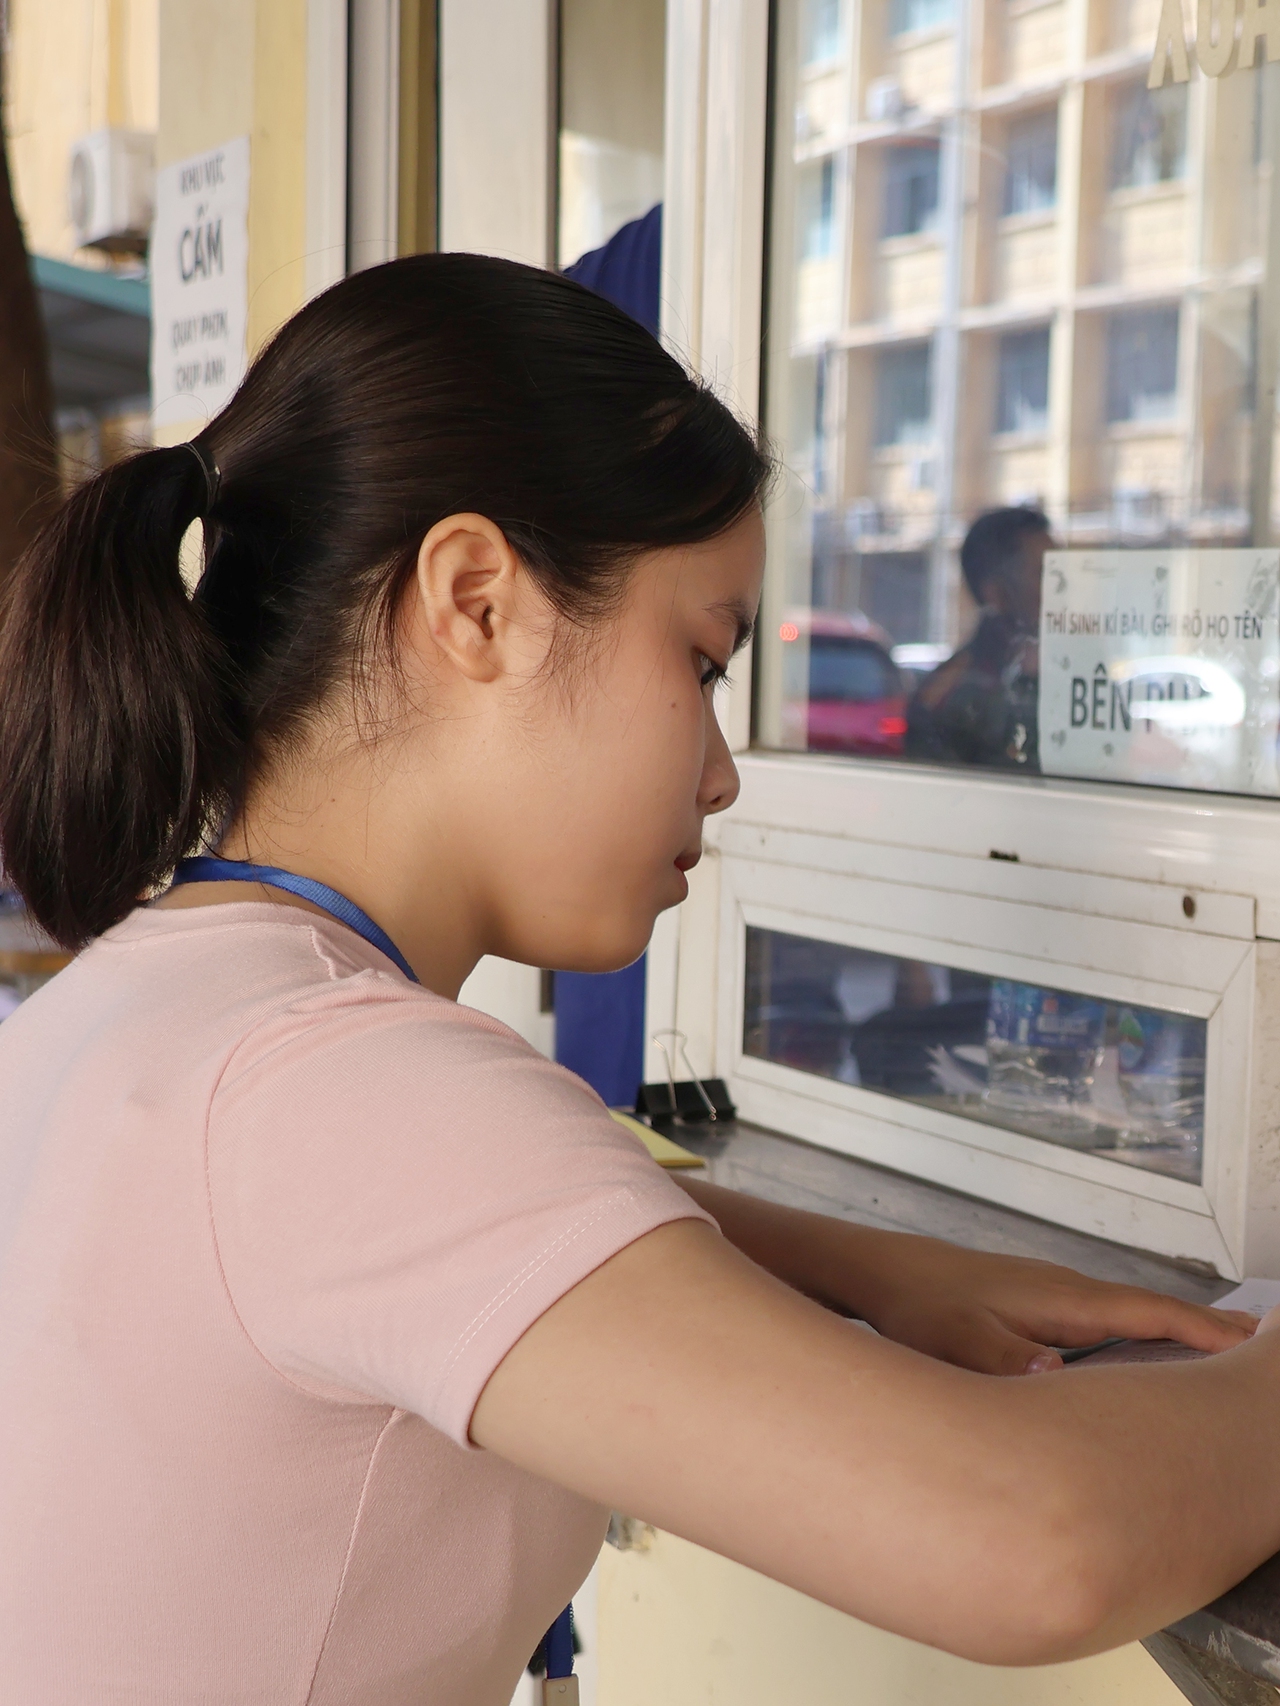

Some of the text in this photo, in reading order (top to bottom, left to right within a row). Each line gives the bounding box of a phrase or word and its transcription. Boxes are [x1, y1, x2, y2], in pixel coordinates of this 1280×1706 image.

[1046, 606, 1067, 634] THÍ
[1069, 613, 1100, 635] SINH
[1234, 610, 1262, 639] TÊN
[1070, 663, 1132, 732] BÊN
